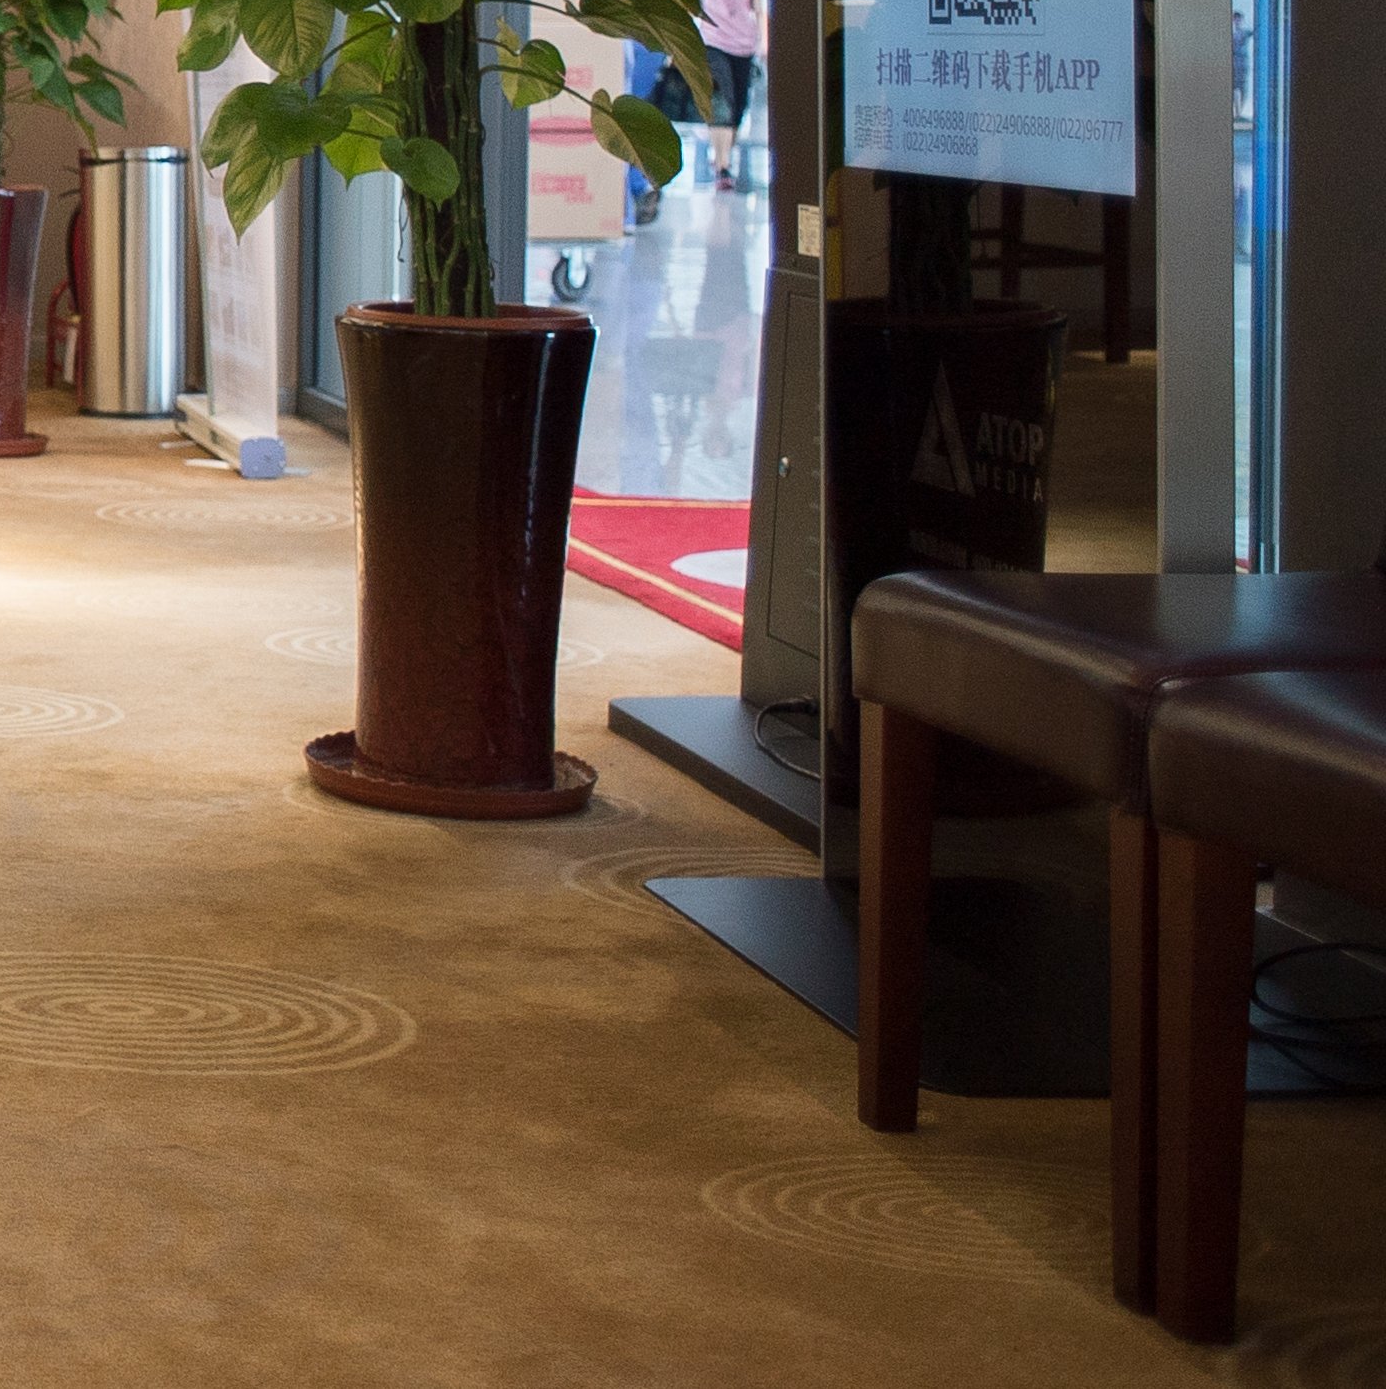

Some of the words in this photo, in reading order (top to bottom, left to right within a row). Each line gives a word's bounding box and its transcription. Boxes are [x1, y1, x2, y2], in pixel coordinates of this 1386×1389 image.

[877, 47, 1101, 95] 扫描二维码下载手机APP
